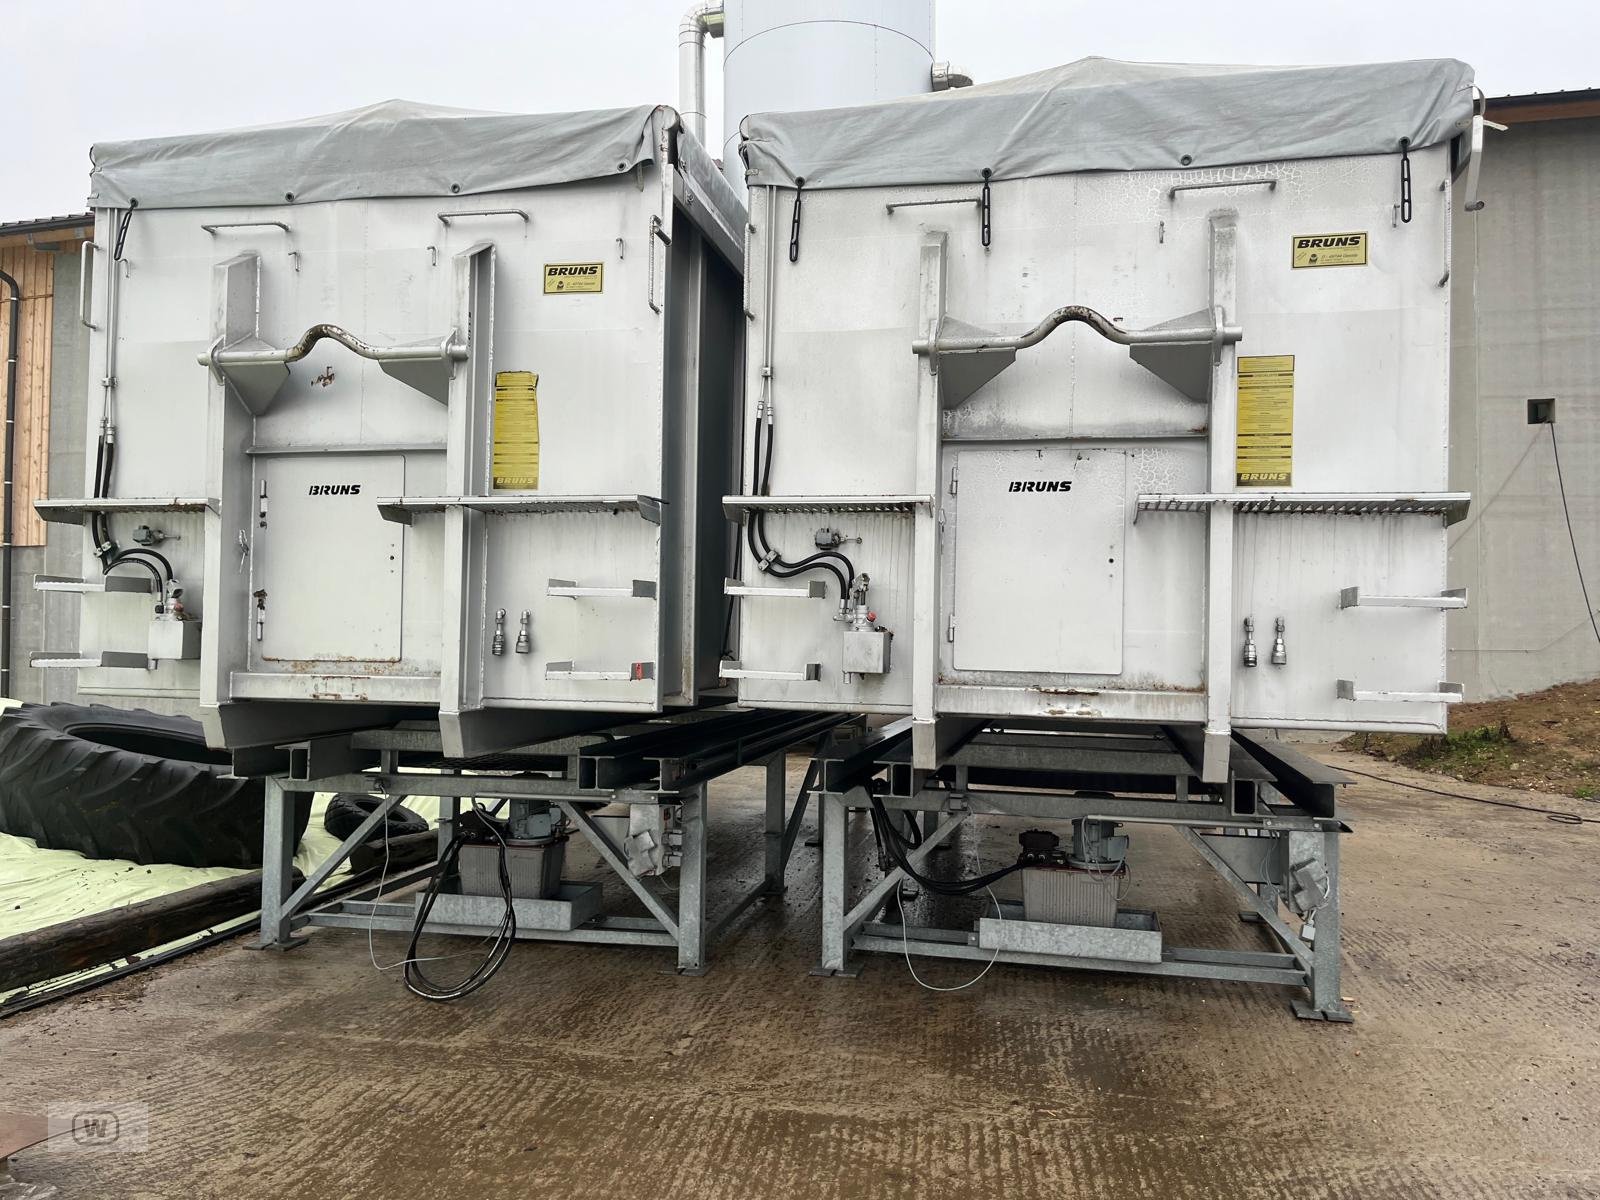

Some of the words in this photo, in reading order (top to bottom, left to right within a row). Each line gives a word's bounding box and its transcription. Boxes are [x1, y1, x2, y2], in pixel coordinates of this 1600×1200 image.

[1297, 236, 1361, 248] BRUNS
[547, 266, 598, 276] BRUNS
[308, 484, 361, 496] BRUNS
[1008, 481, 1072, 492] BRUNS
